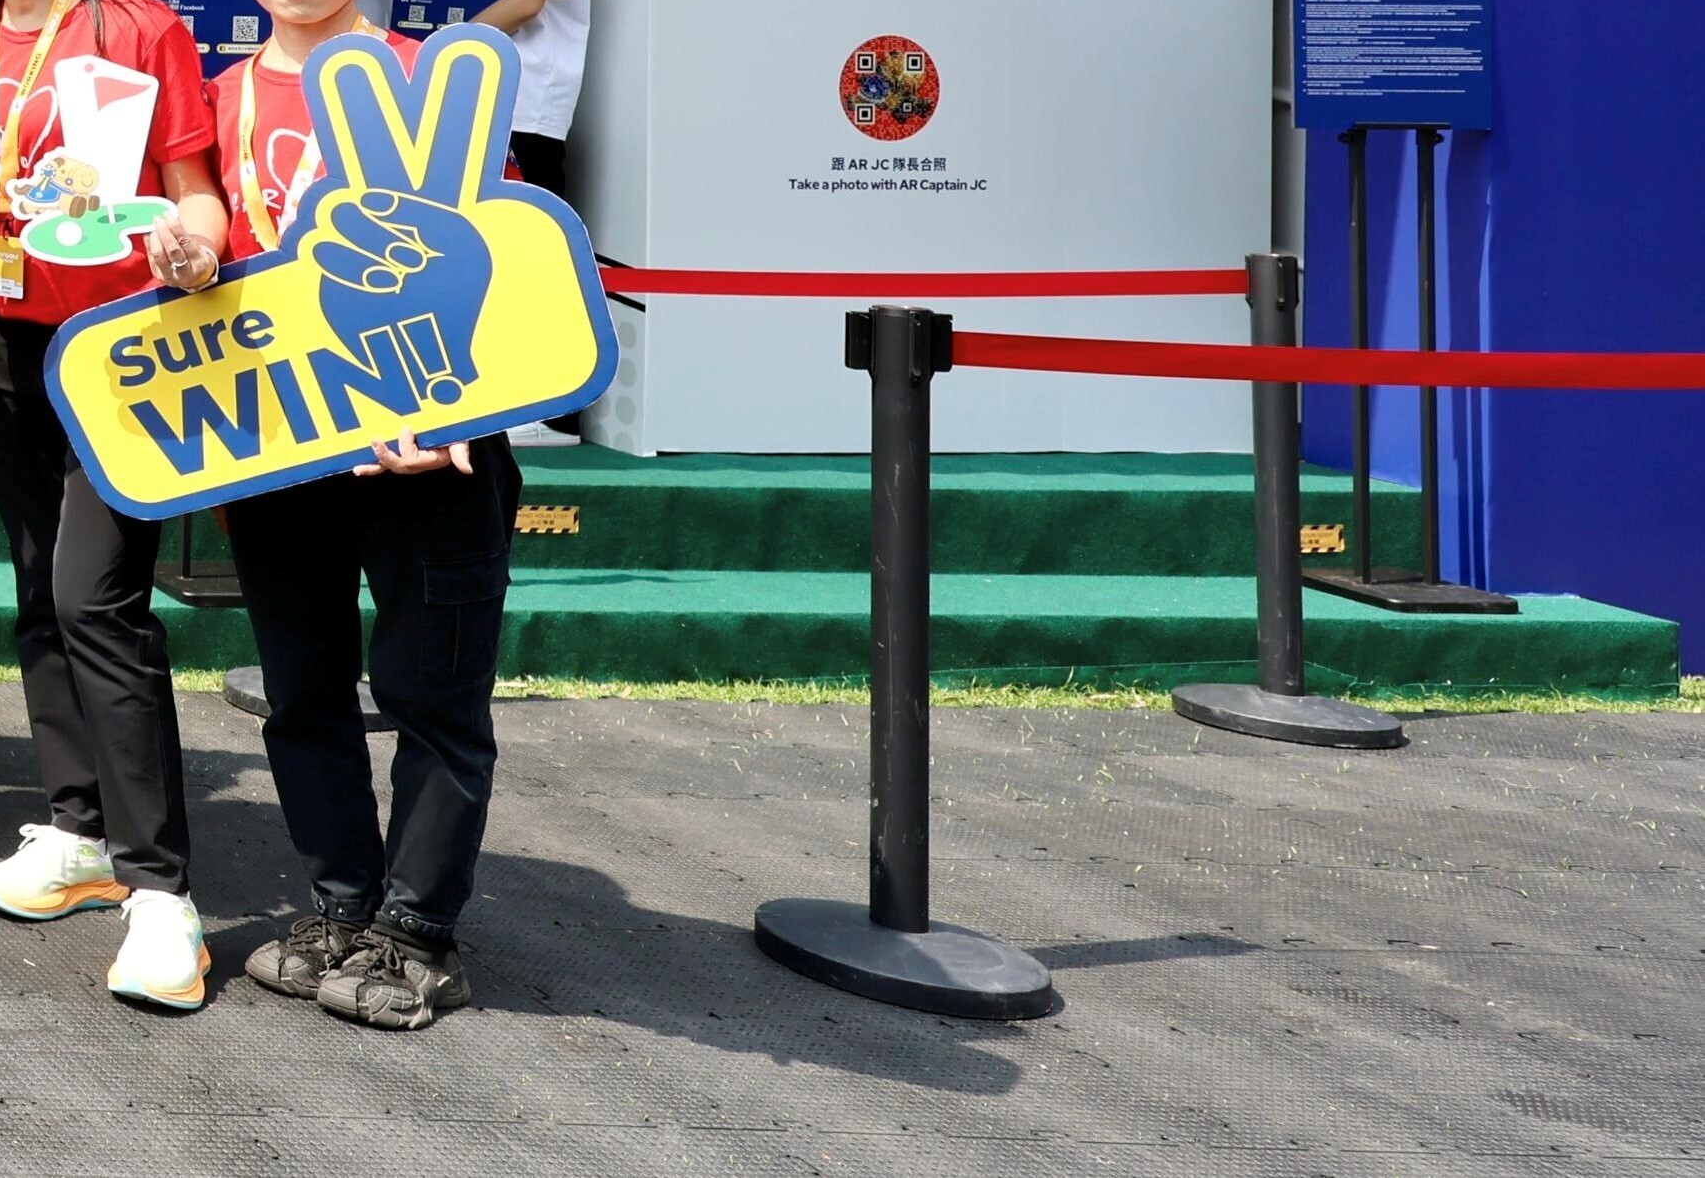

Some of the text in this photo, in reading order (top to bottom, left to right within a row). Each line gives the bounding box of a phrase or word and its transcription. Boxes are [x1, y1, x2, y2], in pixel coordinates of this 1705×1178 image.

[19, 52, 42, 97] WORKING
[789, 179, 987, 193] Take a photo with AR Captain JC
[848, 159, 868, 170] AR
[871, 159, 889, 170] JC
[893, 157, 946, 171] 隊長合照
[110, 310, 276, 387] Sure
[129, 312, 464, 476] WIN!
